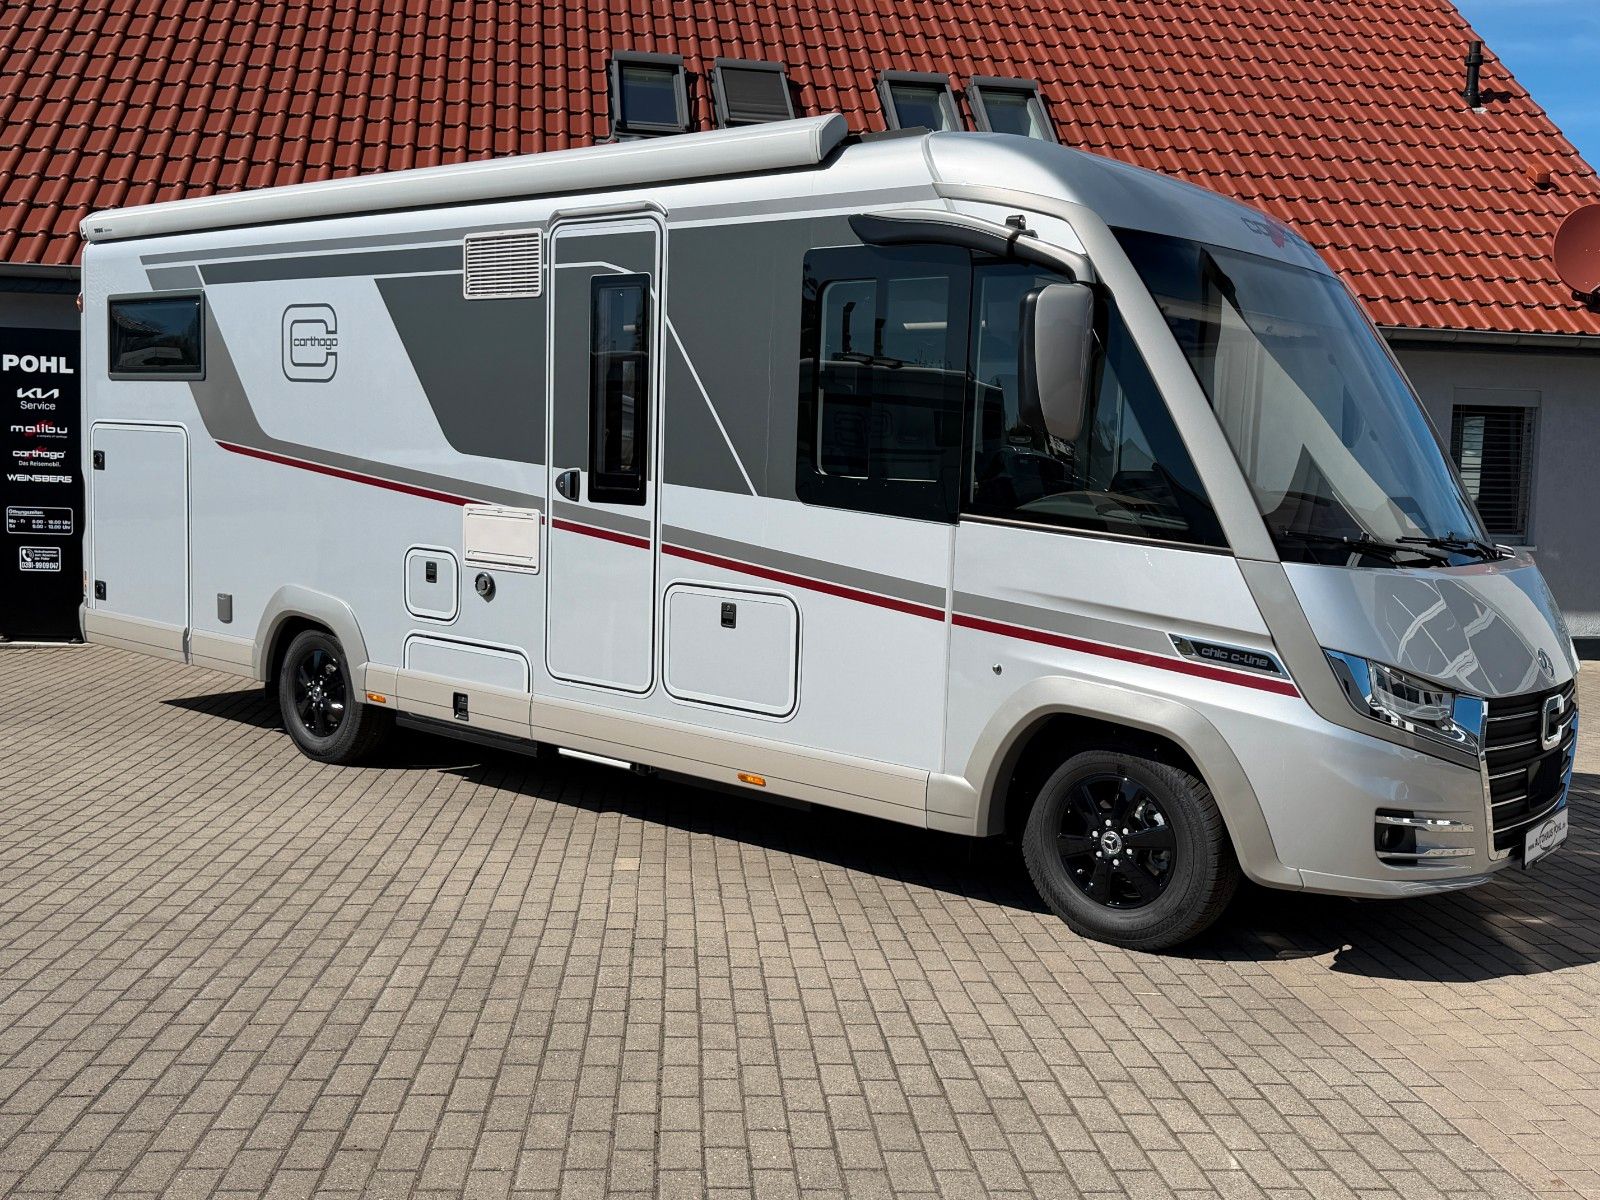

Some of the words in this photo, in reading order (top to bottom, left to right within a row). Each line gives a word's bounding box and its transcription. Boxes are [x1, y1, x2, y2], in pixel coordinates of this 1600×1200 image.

[293, 336, 338, 350] carthago
[2, 354, 74, 374] POHL
[17, 387, 59, 399] KIA
[20, 400, 56, 410] Service
[10, 424, 68, 434] malibu
[12, 450, 65, 460] carthago
[7, 474, 72, 483] WEINSBERG
[1201, 647, 1228, 660] chic
[1230, 653, 1268, 667] c-line
